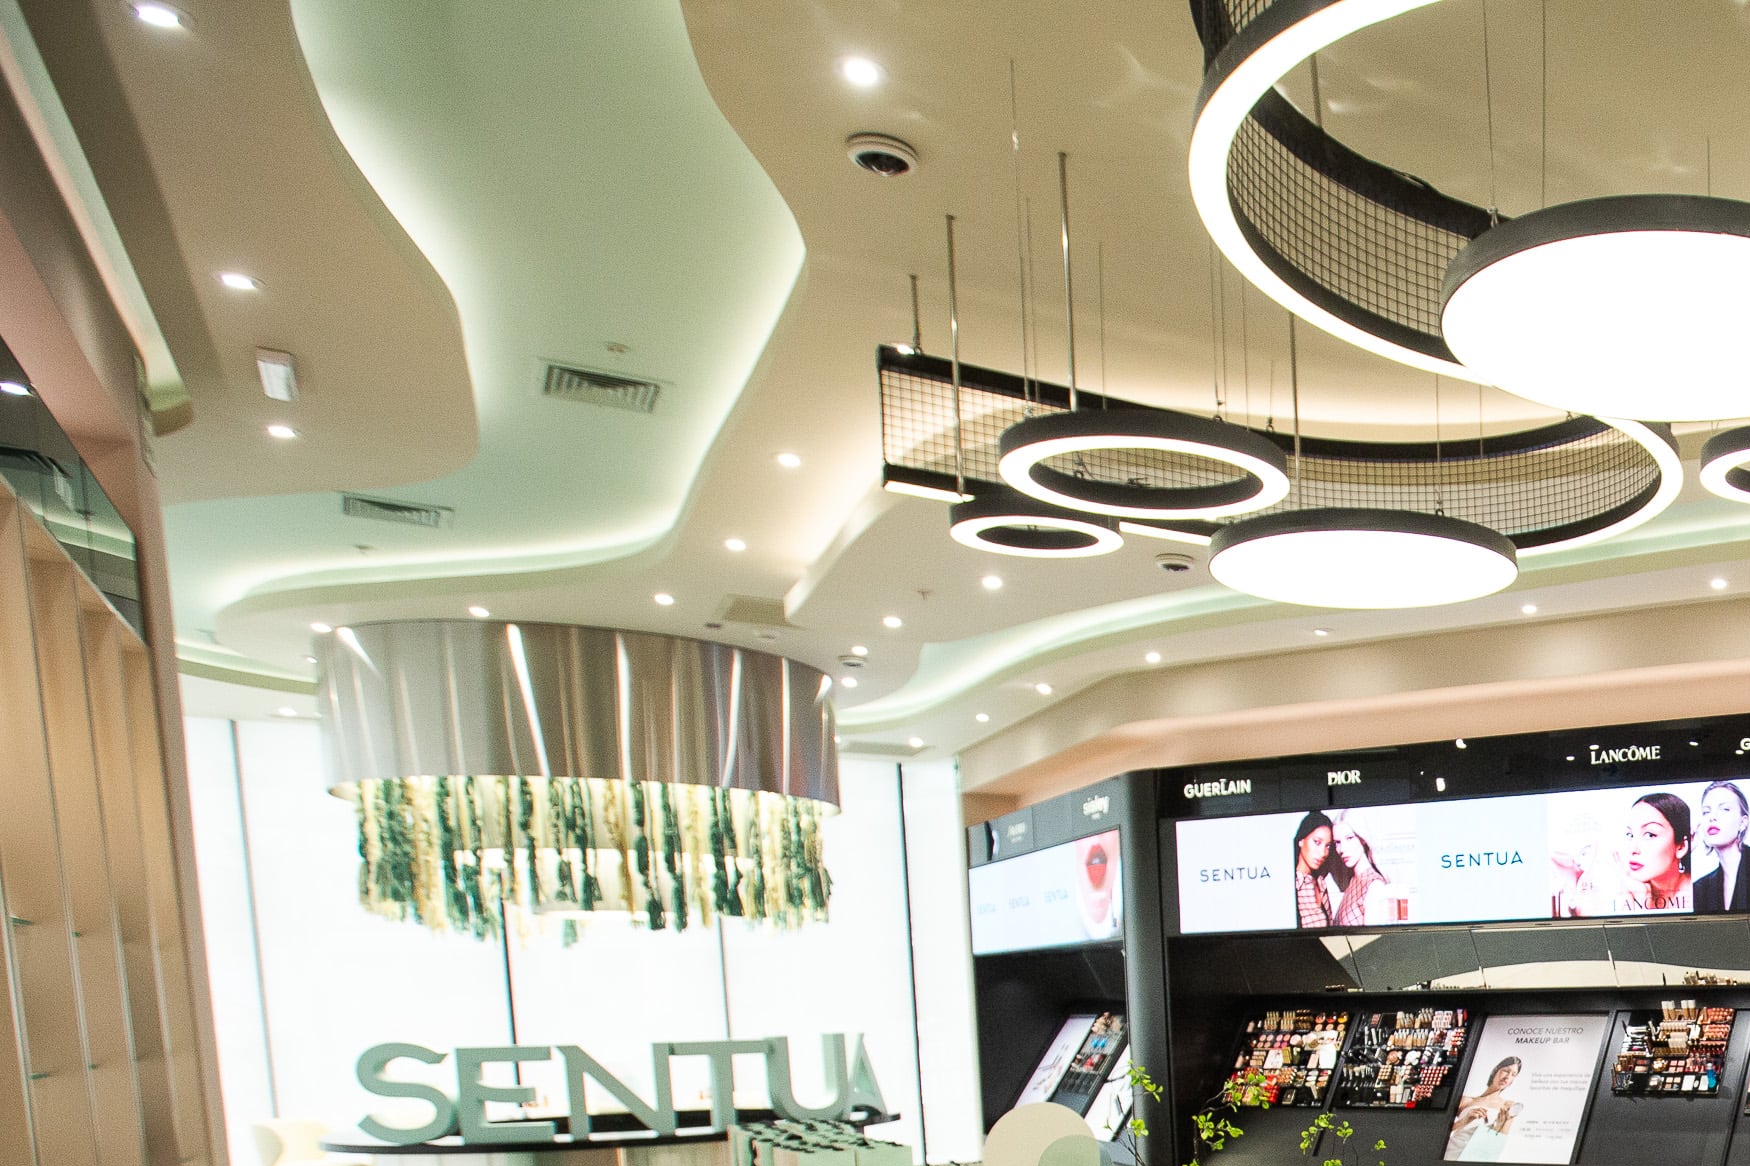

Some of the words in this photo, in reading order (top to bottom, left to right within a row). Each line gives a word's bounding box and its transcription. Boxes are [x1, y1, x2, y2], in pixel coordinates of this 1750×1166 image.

[1590, 745, 1662, 765] LANCÔME
[1327, 769, 1361, 786] DIOR
[1183, 778, 1252, 799] GUERLAIN
[1440, 850, 1523, 869] SENTUA
[1199, 866, 1271, 883] SENTUA
[1507, 1027, 1543, 1036] CONOCE
[1544, 1027, 1584, 1035] NUESTRO
[1515, 1037, 1551, 1045] MAKEUP
[356, 1032, 888, 1145] SENTUA
